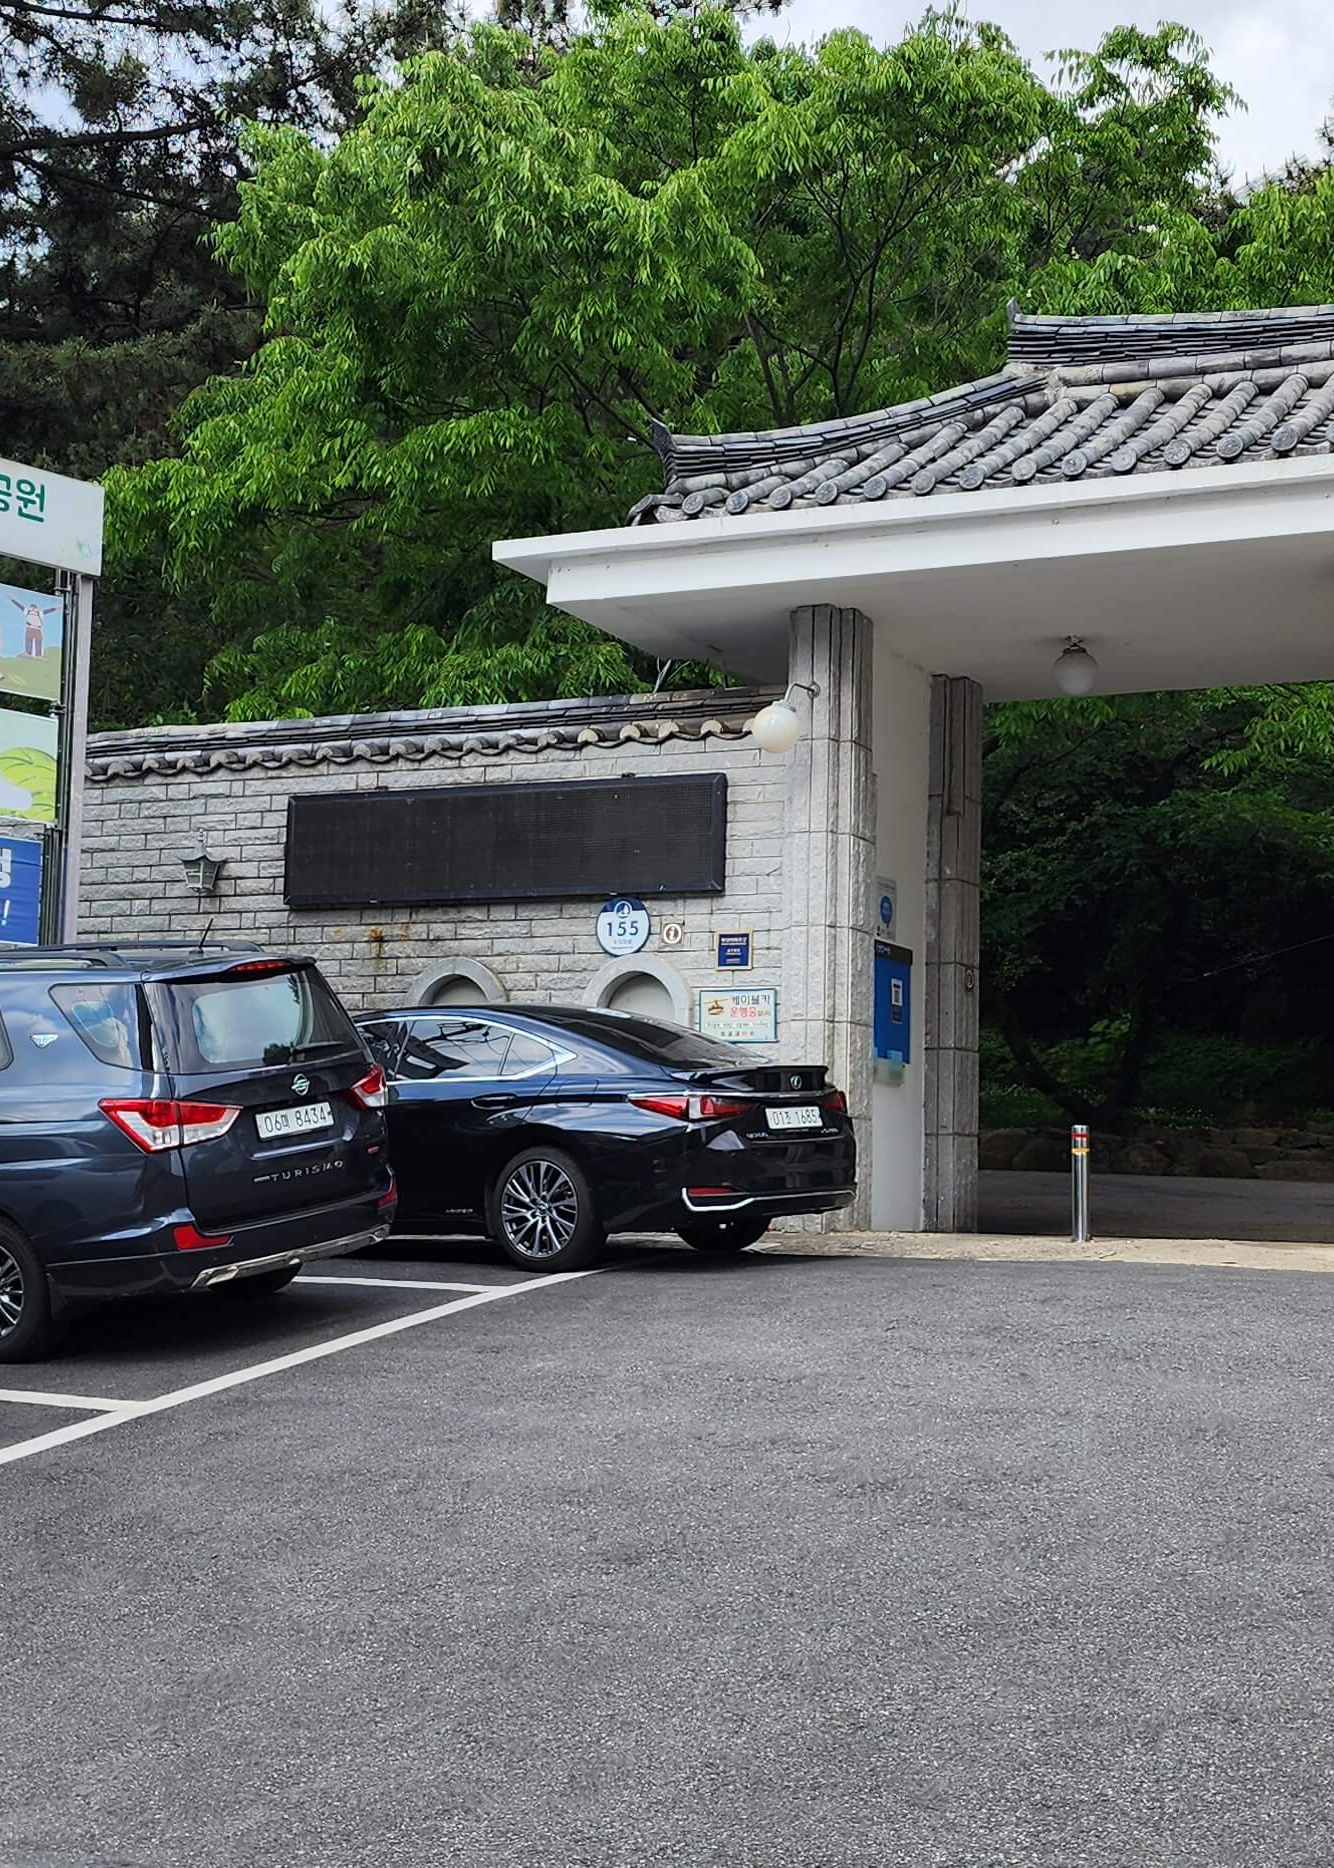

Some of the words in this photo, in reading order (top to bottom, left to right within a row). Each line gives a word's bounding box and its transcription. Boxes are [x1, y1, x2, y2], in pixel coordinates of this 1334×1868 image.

[605, 919, 640, 937] 155
[295, 1105, 327, 1127] 8434
[271, 1159, 344, 1182] TURISMO
